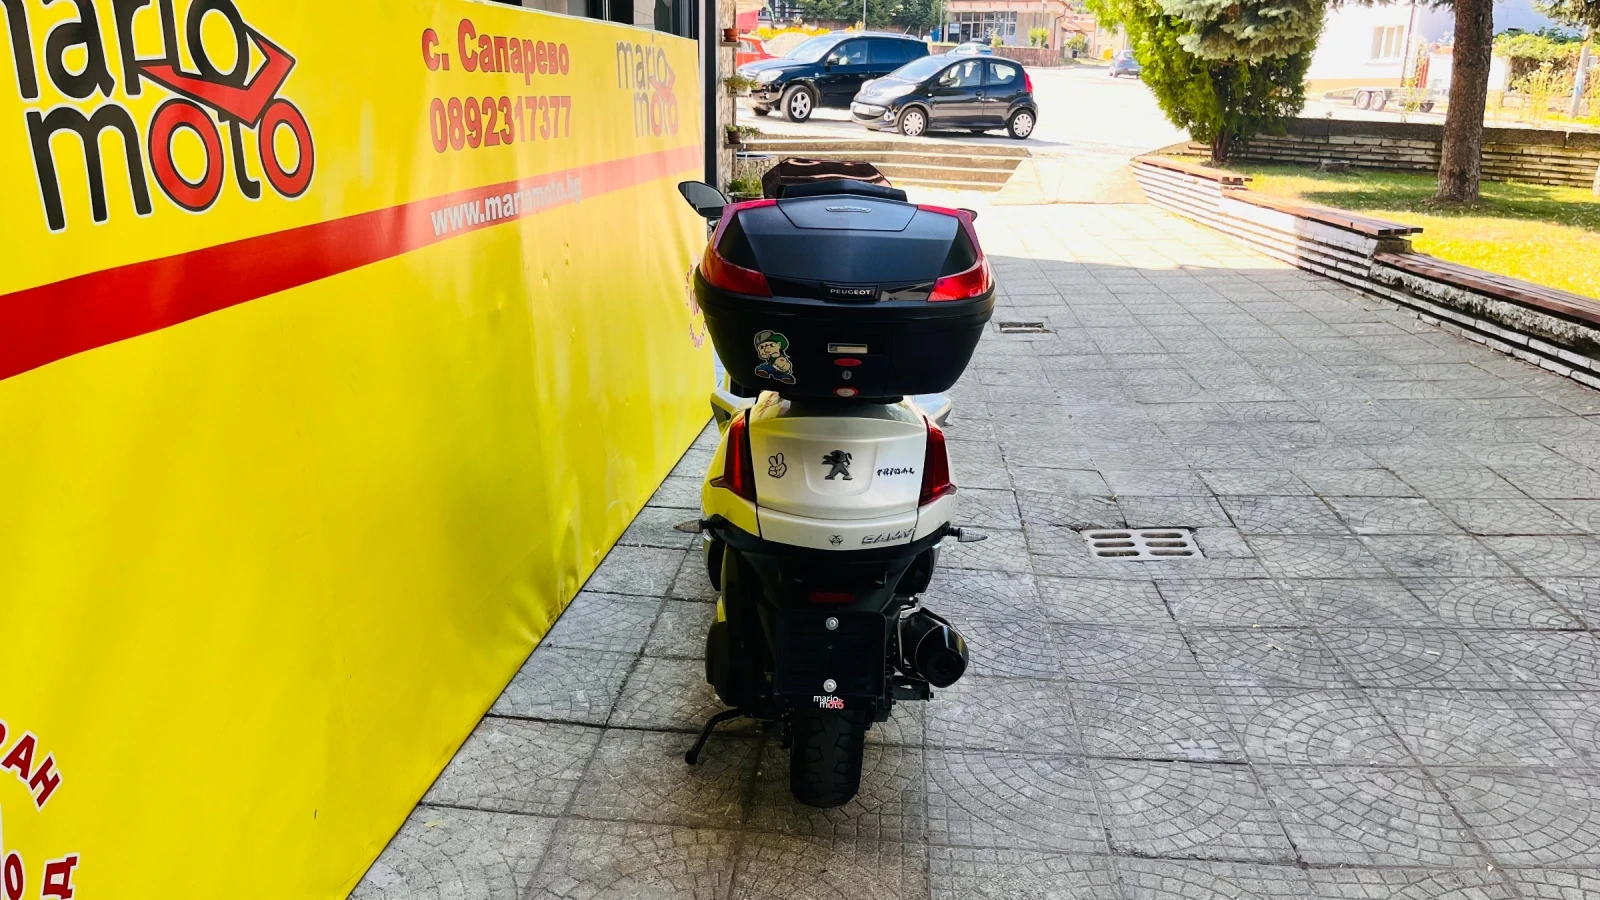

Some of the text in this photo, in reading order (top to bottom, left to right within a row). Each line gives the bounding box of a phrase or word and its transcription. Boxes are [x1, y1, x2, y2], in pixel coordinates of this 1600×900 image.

[457, 18, 570, 86] Сапарево
[616, 33, 669, 91] mario
[429, 95, 572, 153] 0892317377
[633, 91, 679, 137] moto
[26, 98, 315, 232] moto
[430, 173, 581, 237] www.mariomoto.bg
[813, 694, 839, 703] mario
[819, 700, 844, 710] moto
